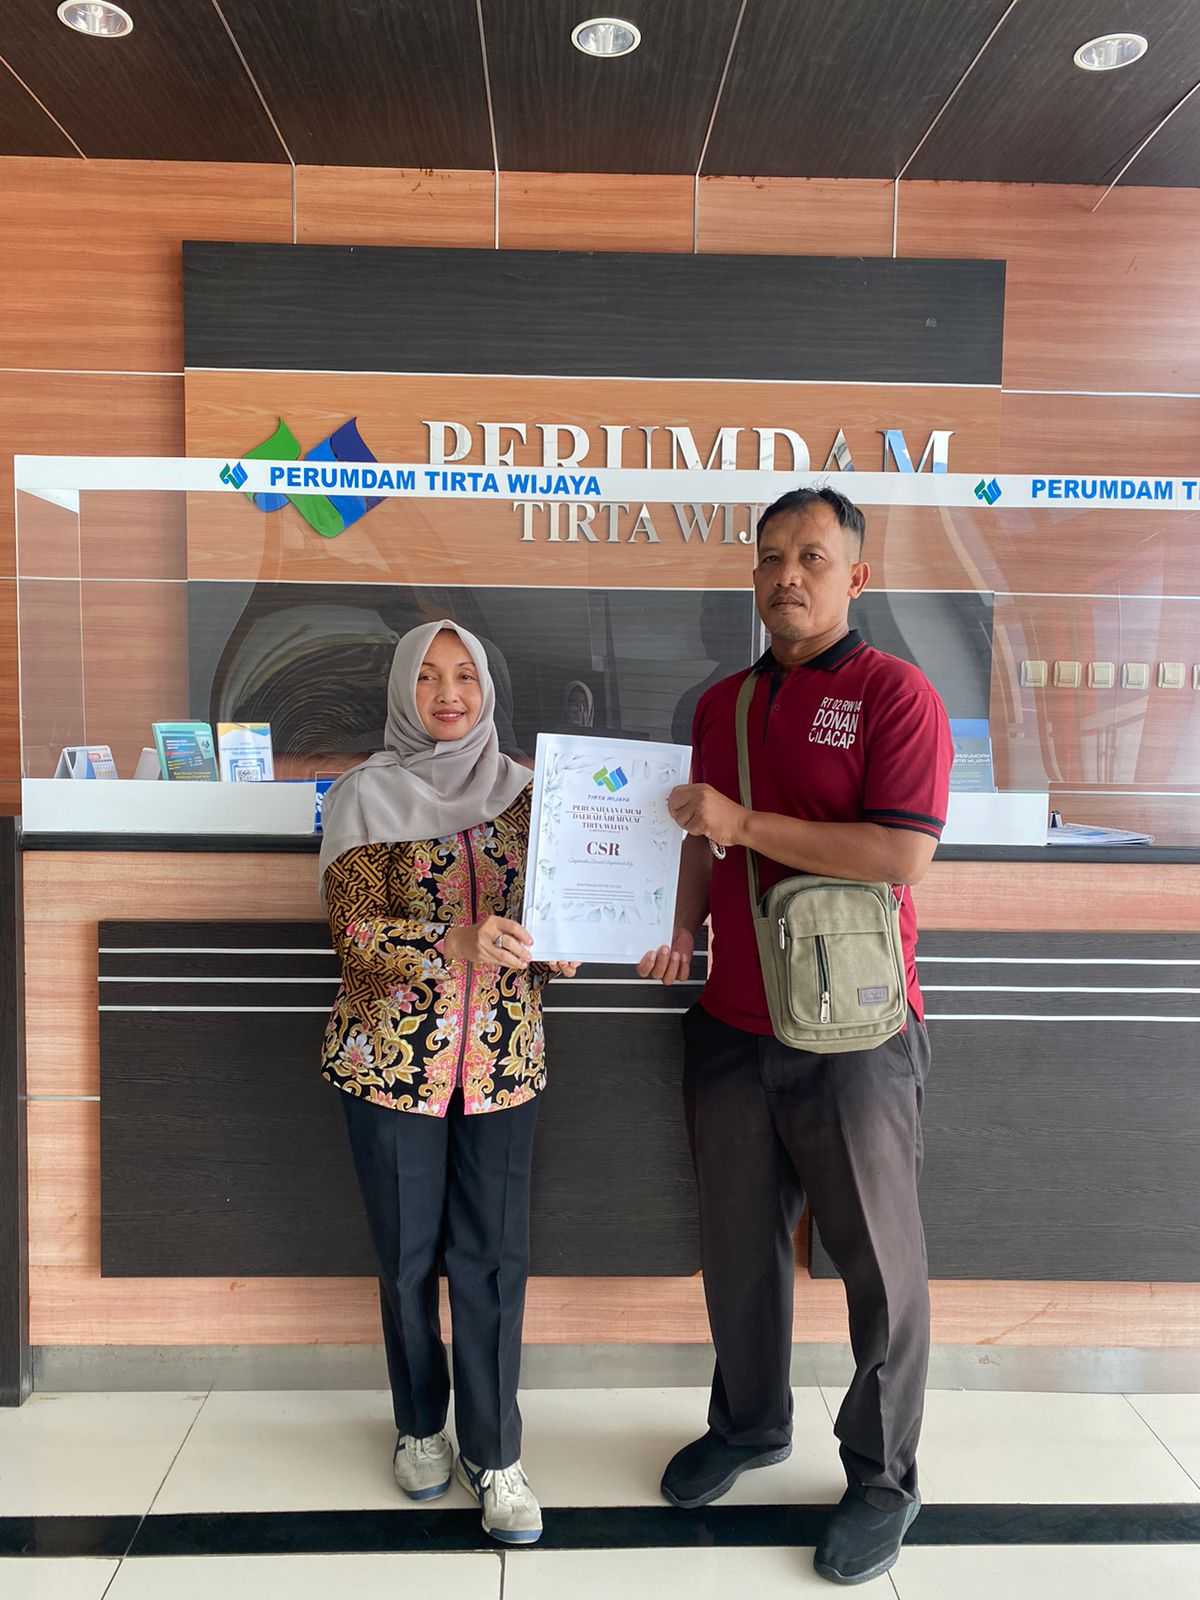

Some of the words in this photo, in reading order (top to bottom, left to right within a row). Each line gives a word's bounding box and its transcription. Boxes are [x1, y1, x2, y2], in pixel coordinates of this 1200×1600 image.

[422, 420, 955, 474] PERUMDAM
[269, 466, 416, 490] PERUMDAM
[425, 470, 499, 493] TIRTA
[507, 473, 602, 496] WIJAYA
[1031, 479, 1173, 501] PERUMDAM
[1182, 481, 1200, 500] T
[513, 500, 662, 544] TIRTA
[671, 502, 757, 544] WIJ
[820, 696, 834, 708] RT
[812, 708, 859, 733] DONAN
[808, 727, 856, 749] CILACAP
[572, 805, 619, 814] PERUSAHAAN
[572, 813, 602, 821] DAERAH
[603, 823, 629, 831] WIJAYA
[586, 841, 620, 856] CSR
